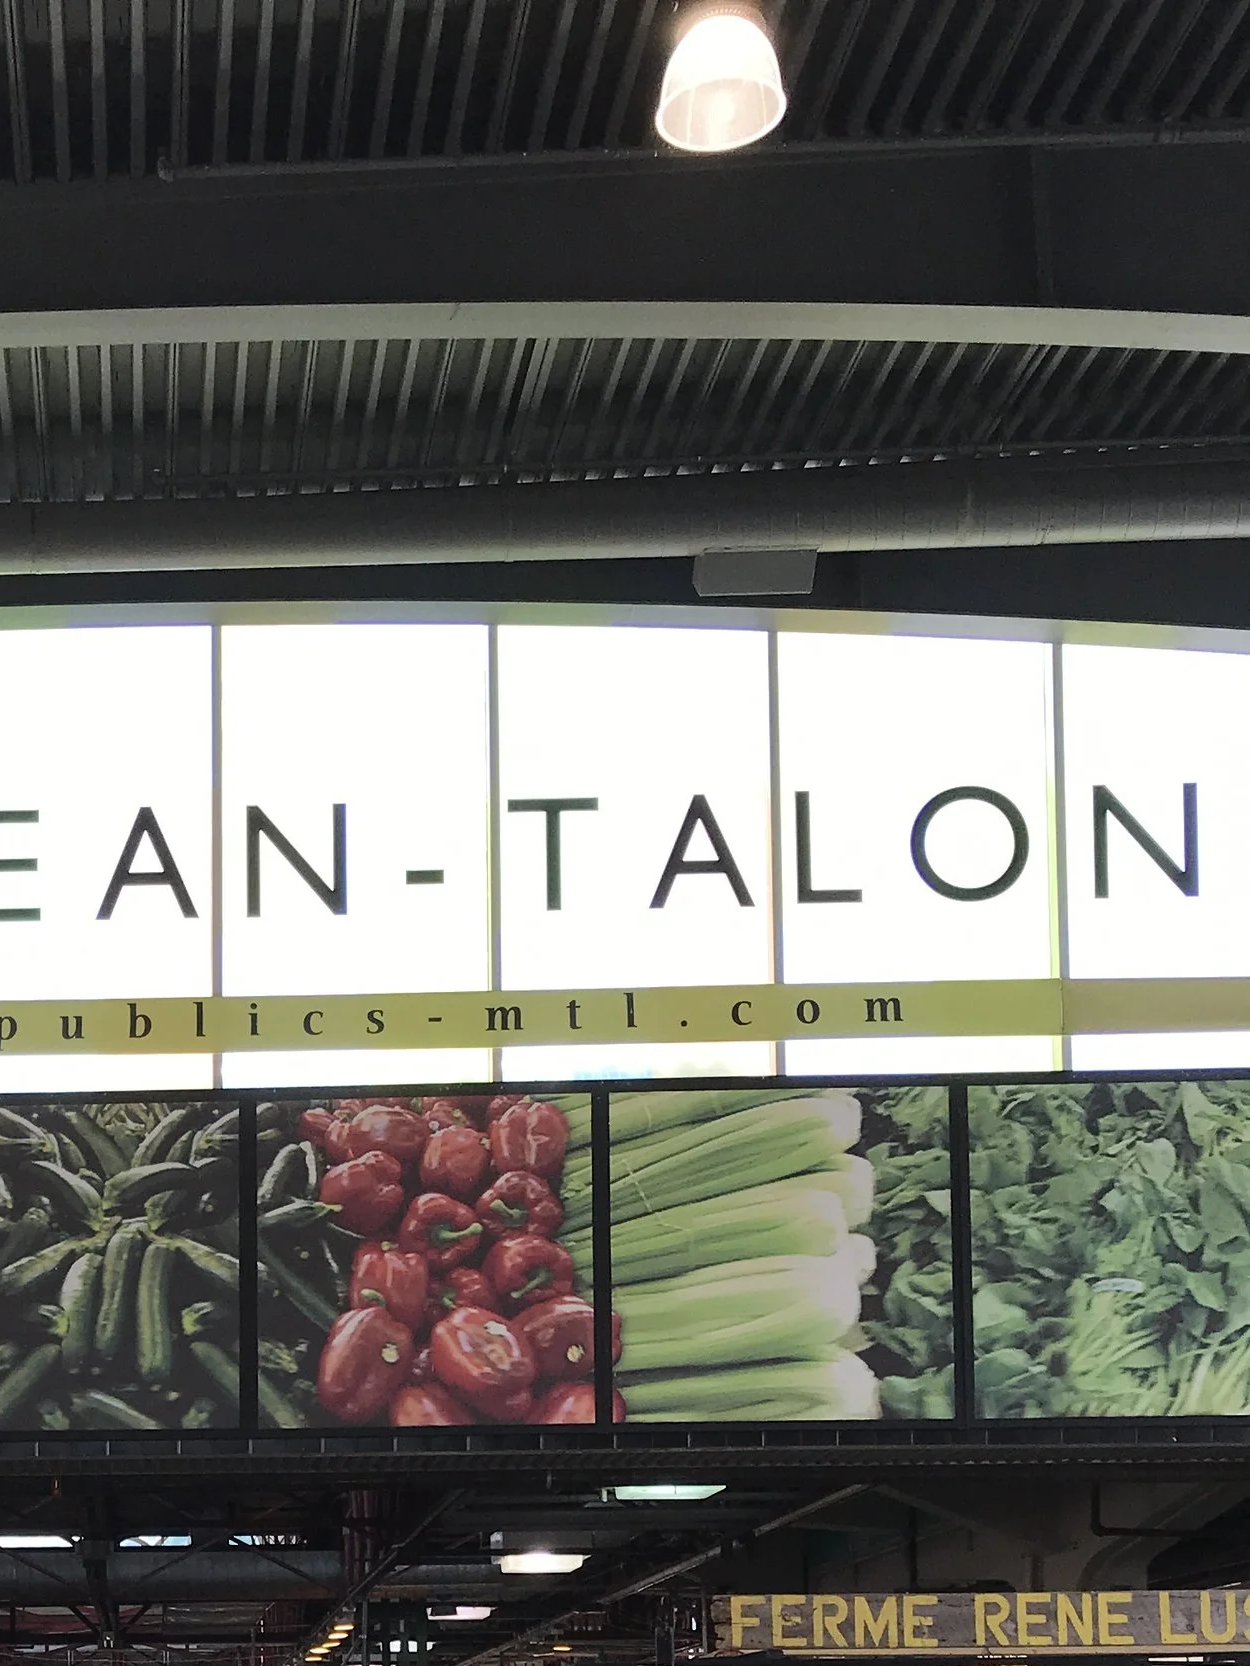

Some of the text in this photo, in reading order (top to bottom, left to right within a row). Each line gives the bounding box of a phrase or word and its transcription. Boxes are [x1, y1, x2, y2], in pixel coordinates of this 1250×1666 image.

[730, 1590, 1250, 1650] FERME RENE LU
